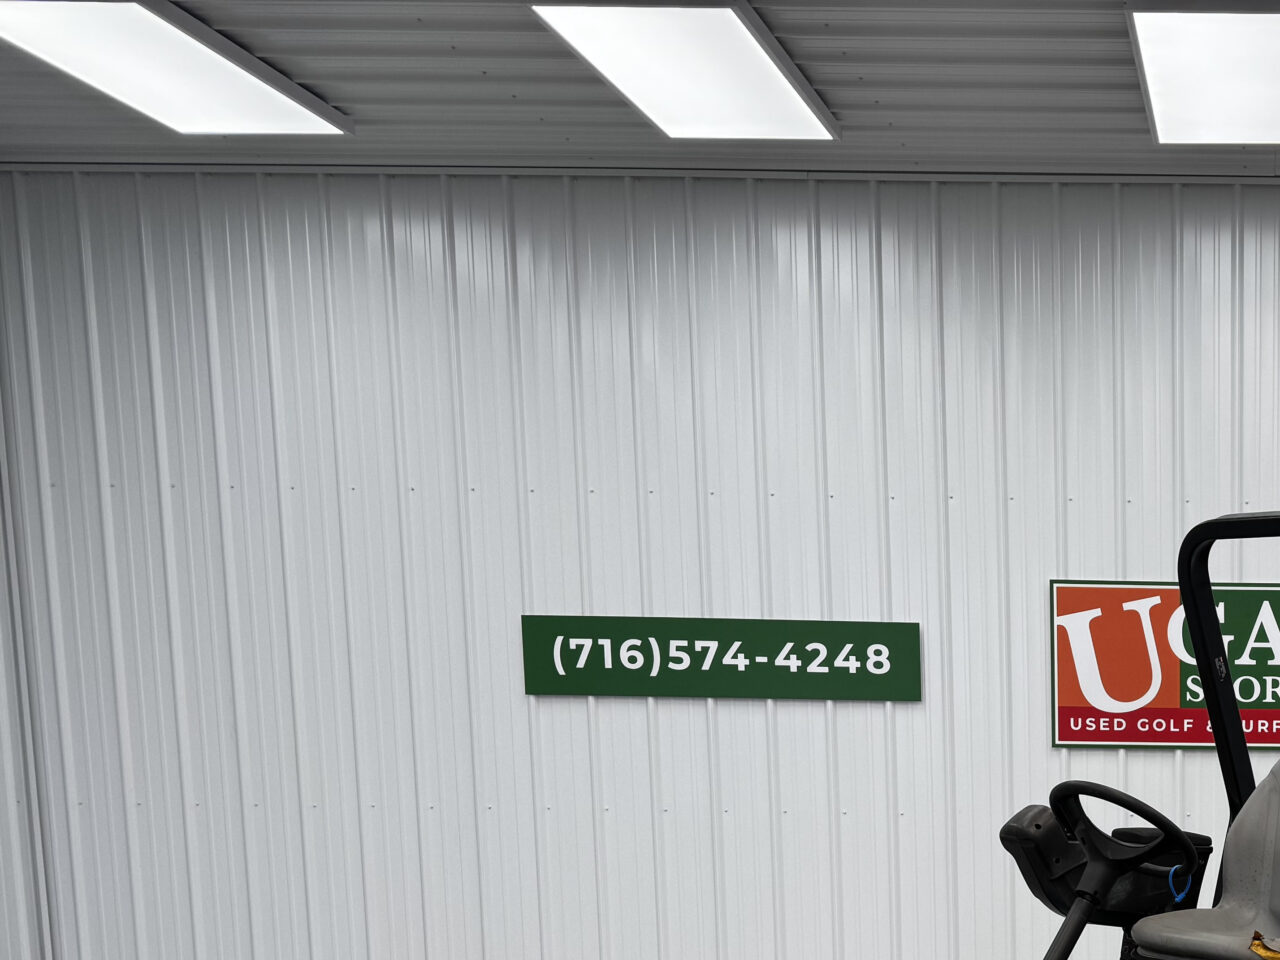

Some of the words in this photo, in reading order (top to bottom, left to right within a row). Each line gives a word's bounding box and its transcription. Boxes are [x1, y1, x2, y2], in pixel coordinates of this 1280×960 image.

[553, 635, 891, 677] (716)574-4248
[1070, 717, 1127, 731] USED
[1137, 718, 1194, 732] GOLF
